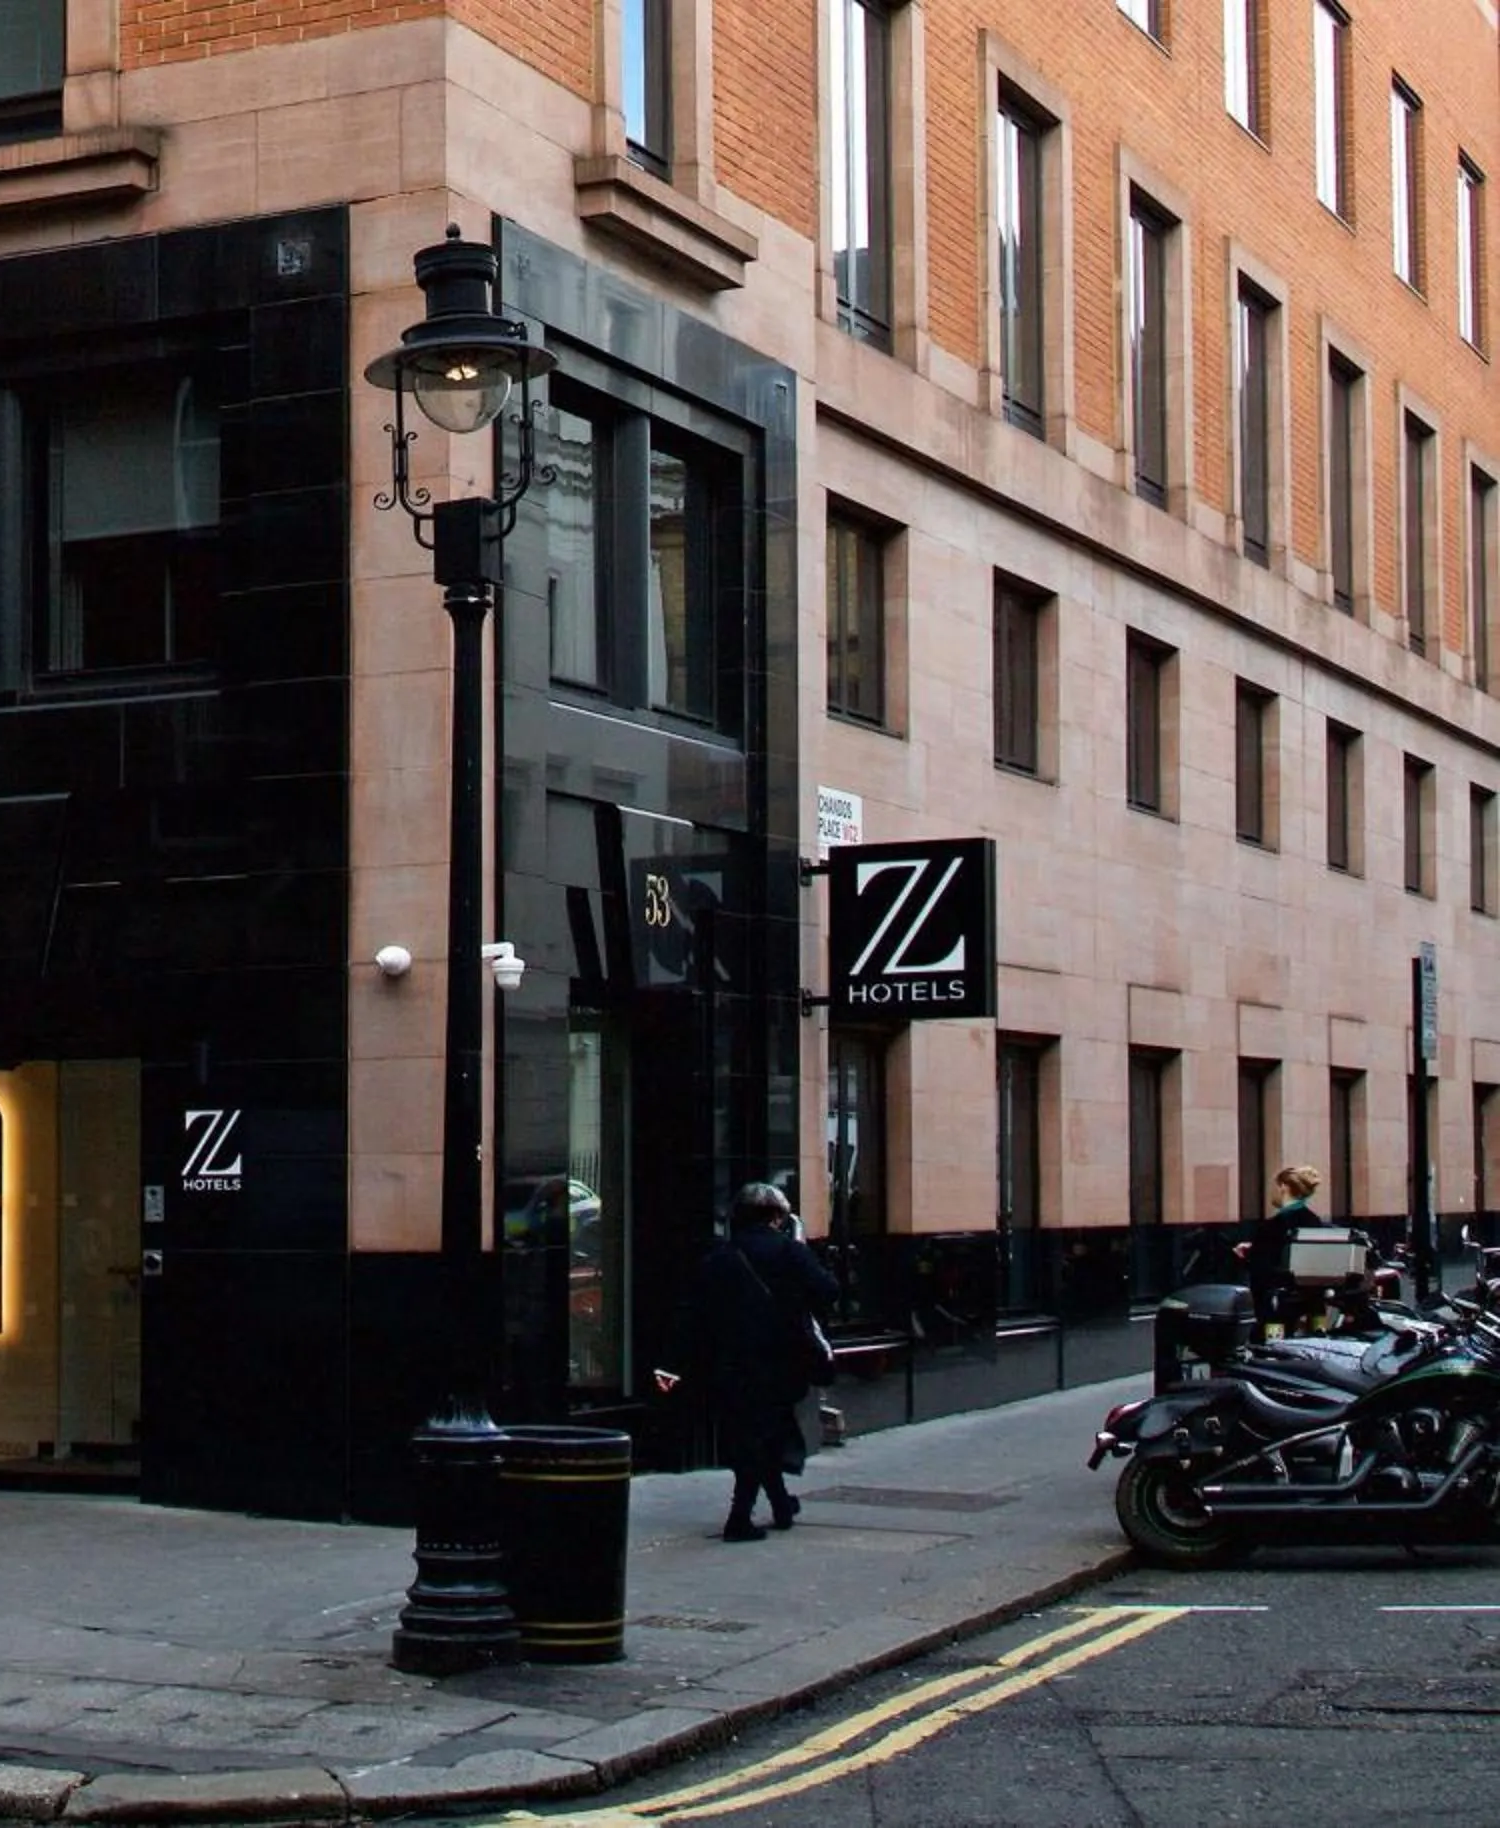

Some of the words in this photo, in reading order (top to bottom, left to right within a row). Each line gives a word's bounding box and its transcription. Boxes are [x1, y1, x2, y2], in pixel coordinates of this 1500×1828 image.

[645, 873, 671, 928] 53
[848, 979, 966, 1004] HOTELS
[183, 1178, 242, 1191] HOTELS
